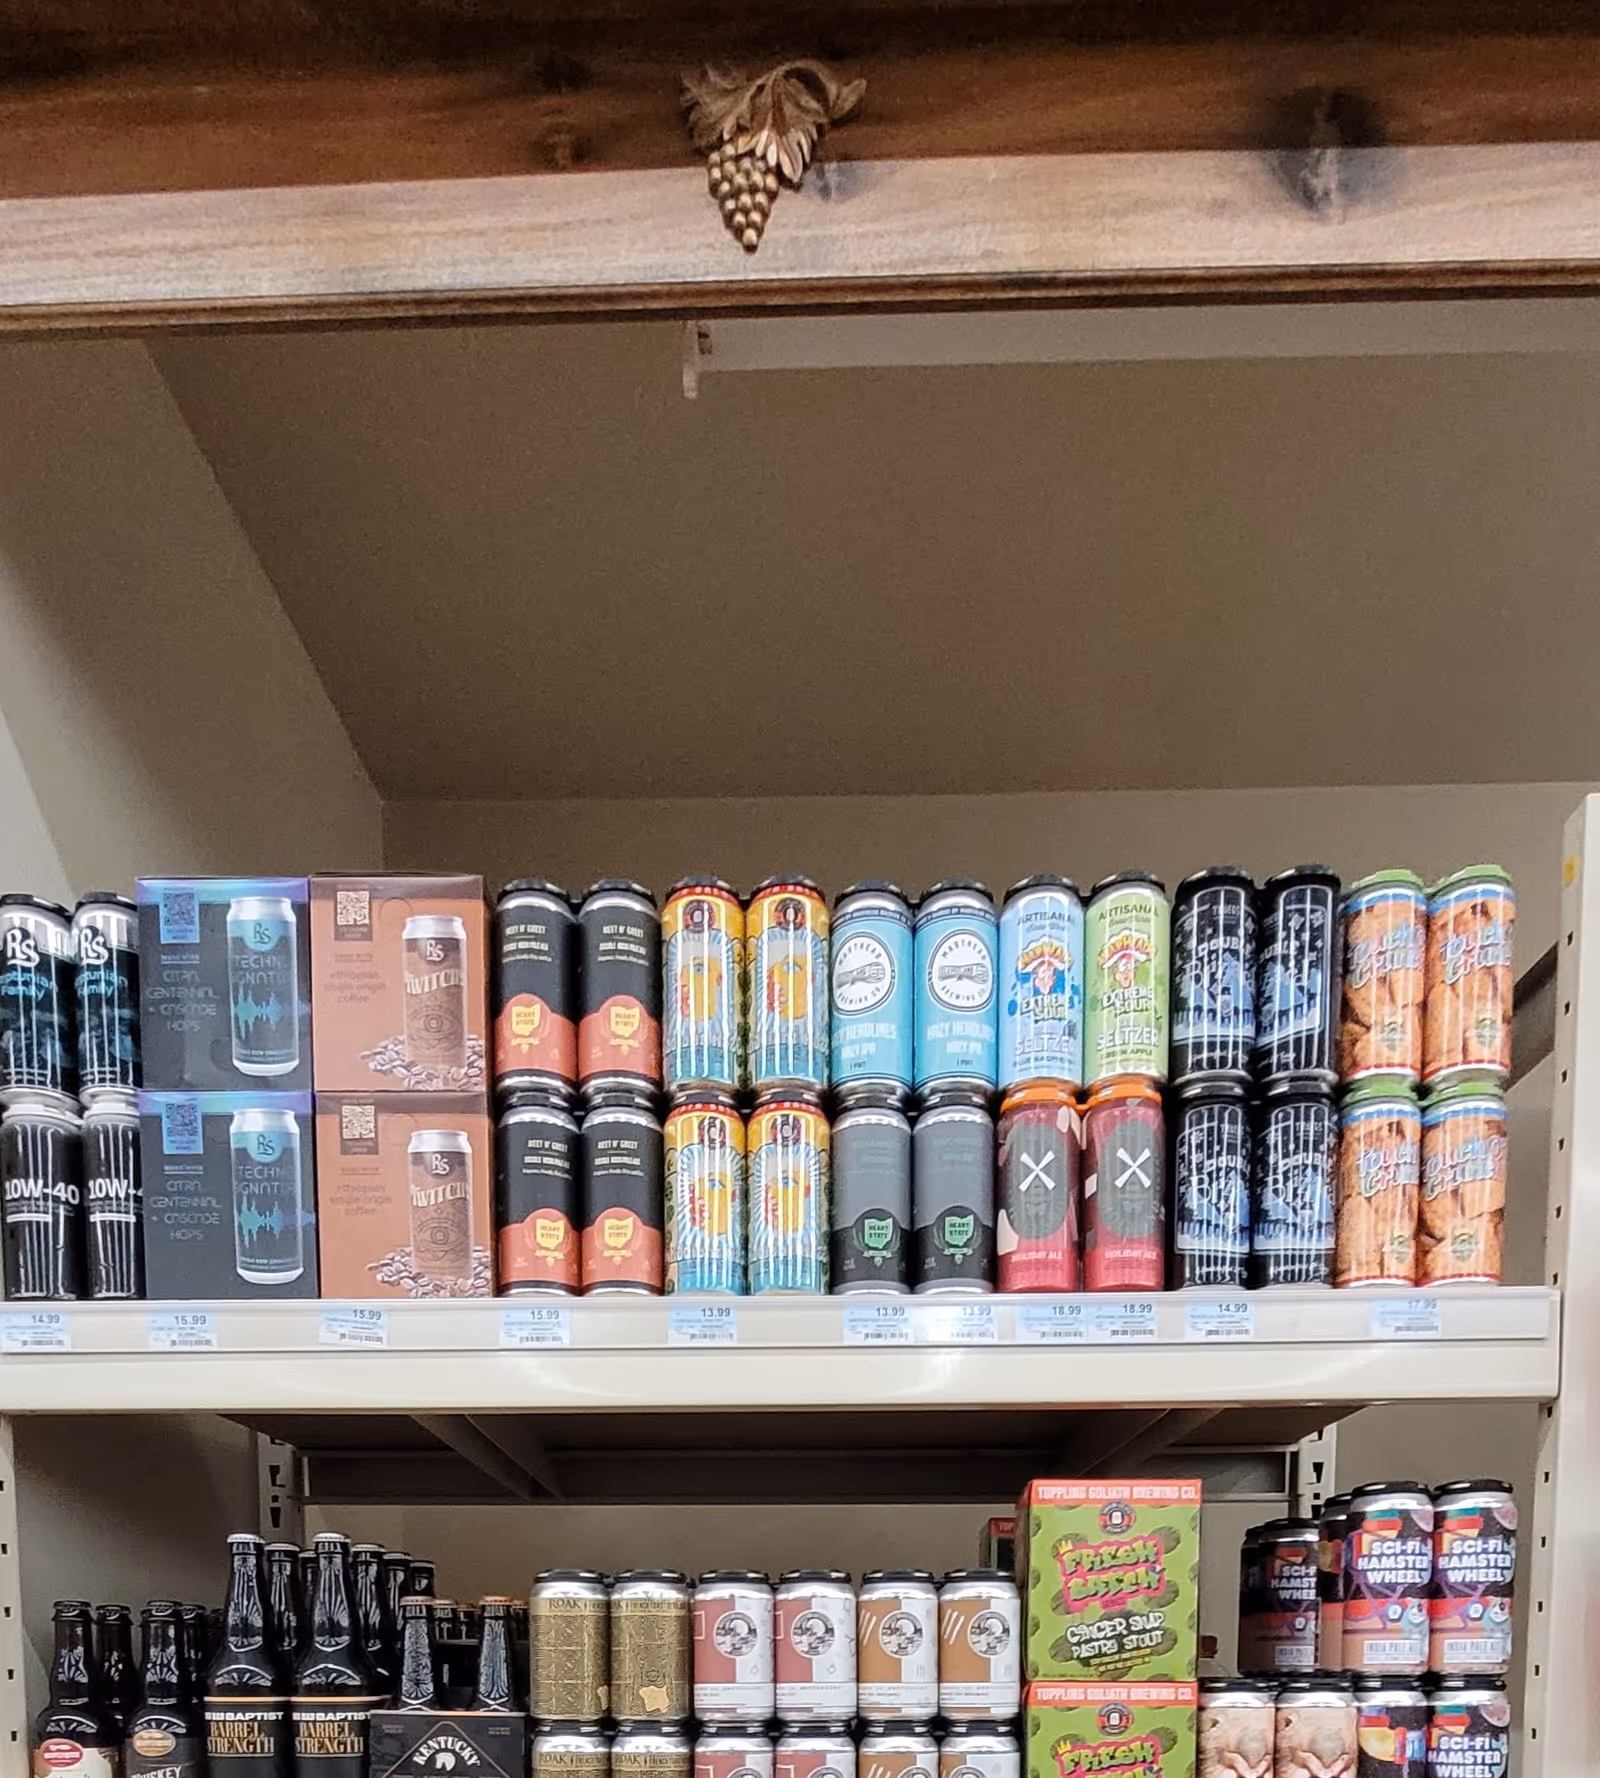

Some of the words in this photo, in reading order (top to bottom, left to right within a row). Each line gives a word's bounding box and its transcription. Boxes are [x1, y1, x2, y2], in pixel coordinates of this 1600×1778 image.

[4, 1178, 80, 1205] 10W-40
[868, 1224, 889, 1232] HEART
[948, 1221, 970, 1229] HEART
[868, 1232, 889, 1240] STATE
[948, 1229, 970, 1237] STATE
[352, 1308, 382, 1321] 15.99
[701, 1307, 731, 1317] 13.99
[875, 1307, 905, 1316] 13.99
[1051, 1305, 1082, 1315] 18.99
[1122, 1303, 1153, 1314] 18.99
[1217, 1303, 1248, 1313] 14.99
[31, 1314, 60, 1325] 14.99
[174, 1315, 207, 1326] 15.99
[530, 1310, 560, 1320] 15.99
[1037, 1486, 1088, 1499] TOPPLING
[1089, 1486, 1131, 1499] GOLIATH
[1371, 1540, 1421, 1555] SCI-FI
[1451, 1539, 1503, 1554] SCI-FI
[1358, 1556, 1430, 1570] HAMSTER
[1066, 1620, 1129, 1643] GINGER
[1130, 1611, 1165, 1632] SNAP
[1071, 1640, 1118, 1660] PASTRY
[1123, 1630, 1165, 1649] STOUT
[1036, 1687, 1086, 1700] TOPPLING
[1087, 1687, 1129, 1700] GOLIATH
[225, 1711, 284, 1721] BAPTIST
[209, 1721, 265, 1738] BARREL
[299, 1721, 355, 1738] BARREL
[206, 1736, 275, 1754] STRENGTH
[295, 1736, 364, 1754] STRENGTH
[1439, 1736, 1491, 1751] SCI-FI
[412, 1735, 481, 1767] KENTUCKY
[1427, 1750, 1501, 1765] HAMSTER
[1436, 1765, 1493, 1778] WHEEL
